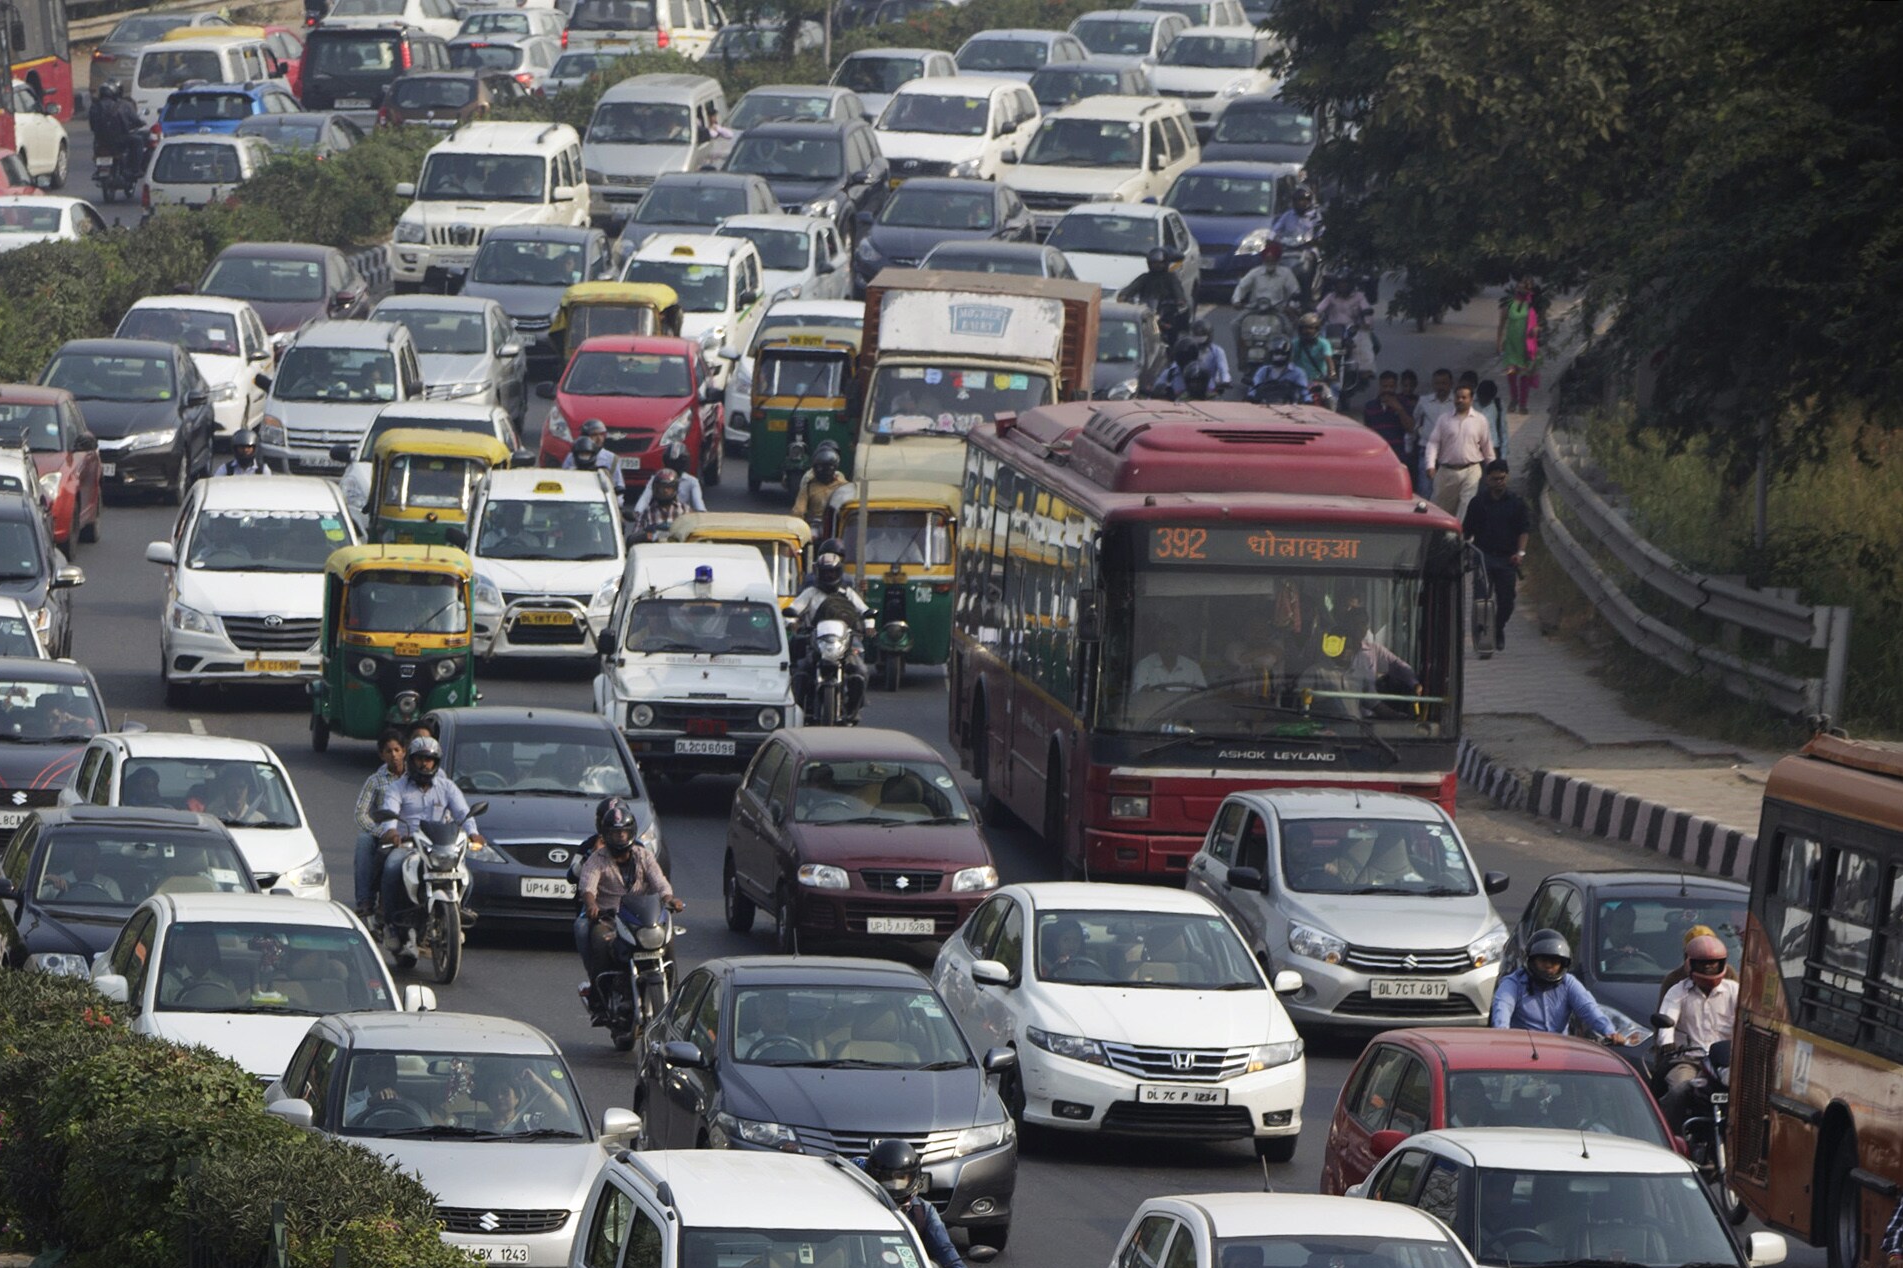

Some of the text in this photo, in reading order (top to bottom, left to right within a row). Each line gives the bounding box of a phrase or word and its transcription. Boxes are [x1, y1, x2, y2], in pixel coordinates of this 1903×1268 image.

[1155, 528, 1207, 558] 392
[1218, 750, 1336, 761] ASHOK LEYLAND
[526, 881, 550, 893] UP14
[871, 920, 894, 931] UP15
[1378, 983, 1447, 998] DL 7CT 4817
[1146, 1091, 1159, 1101] DL
[1162, 1091, 1176, 1101] 7C
[1193, 1092, 1217, 1102] 1234
[500, 1248, 527, 1261] 1243
